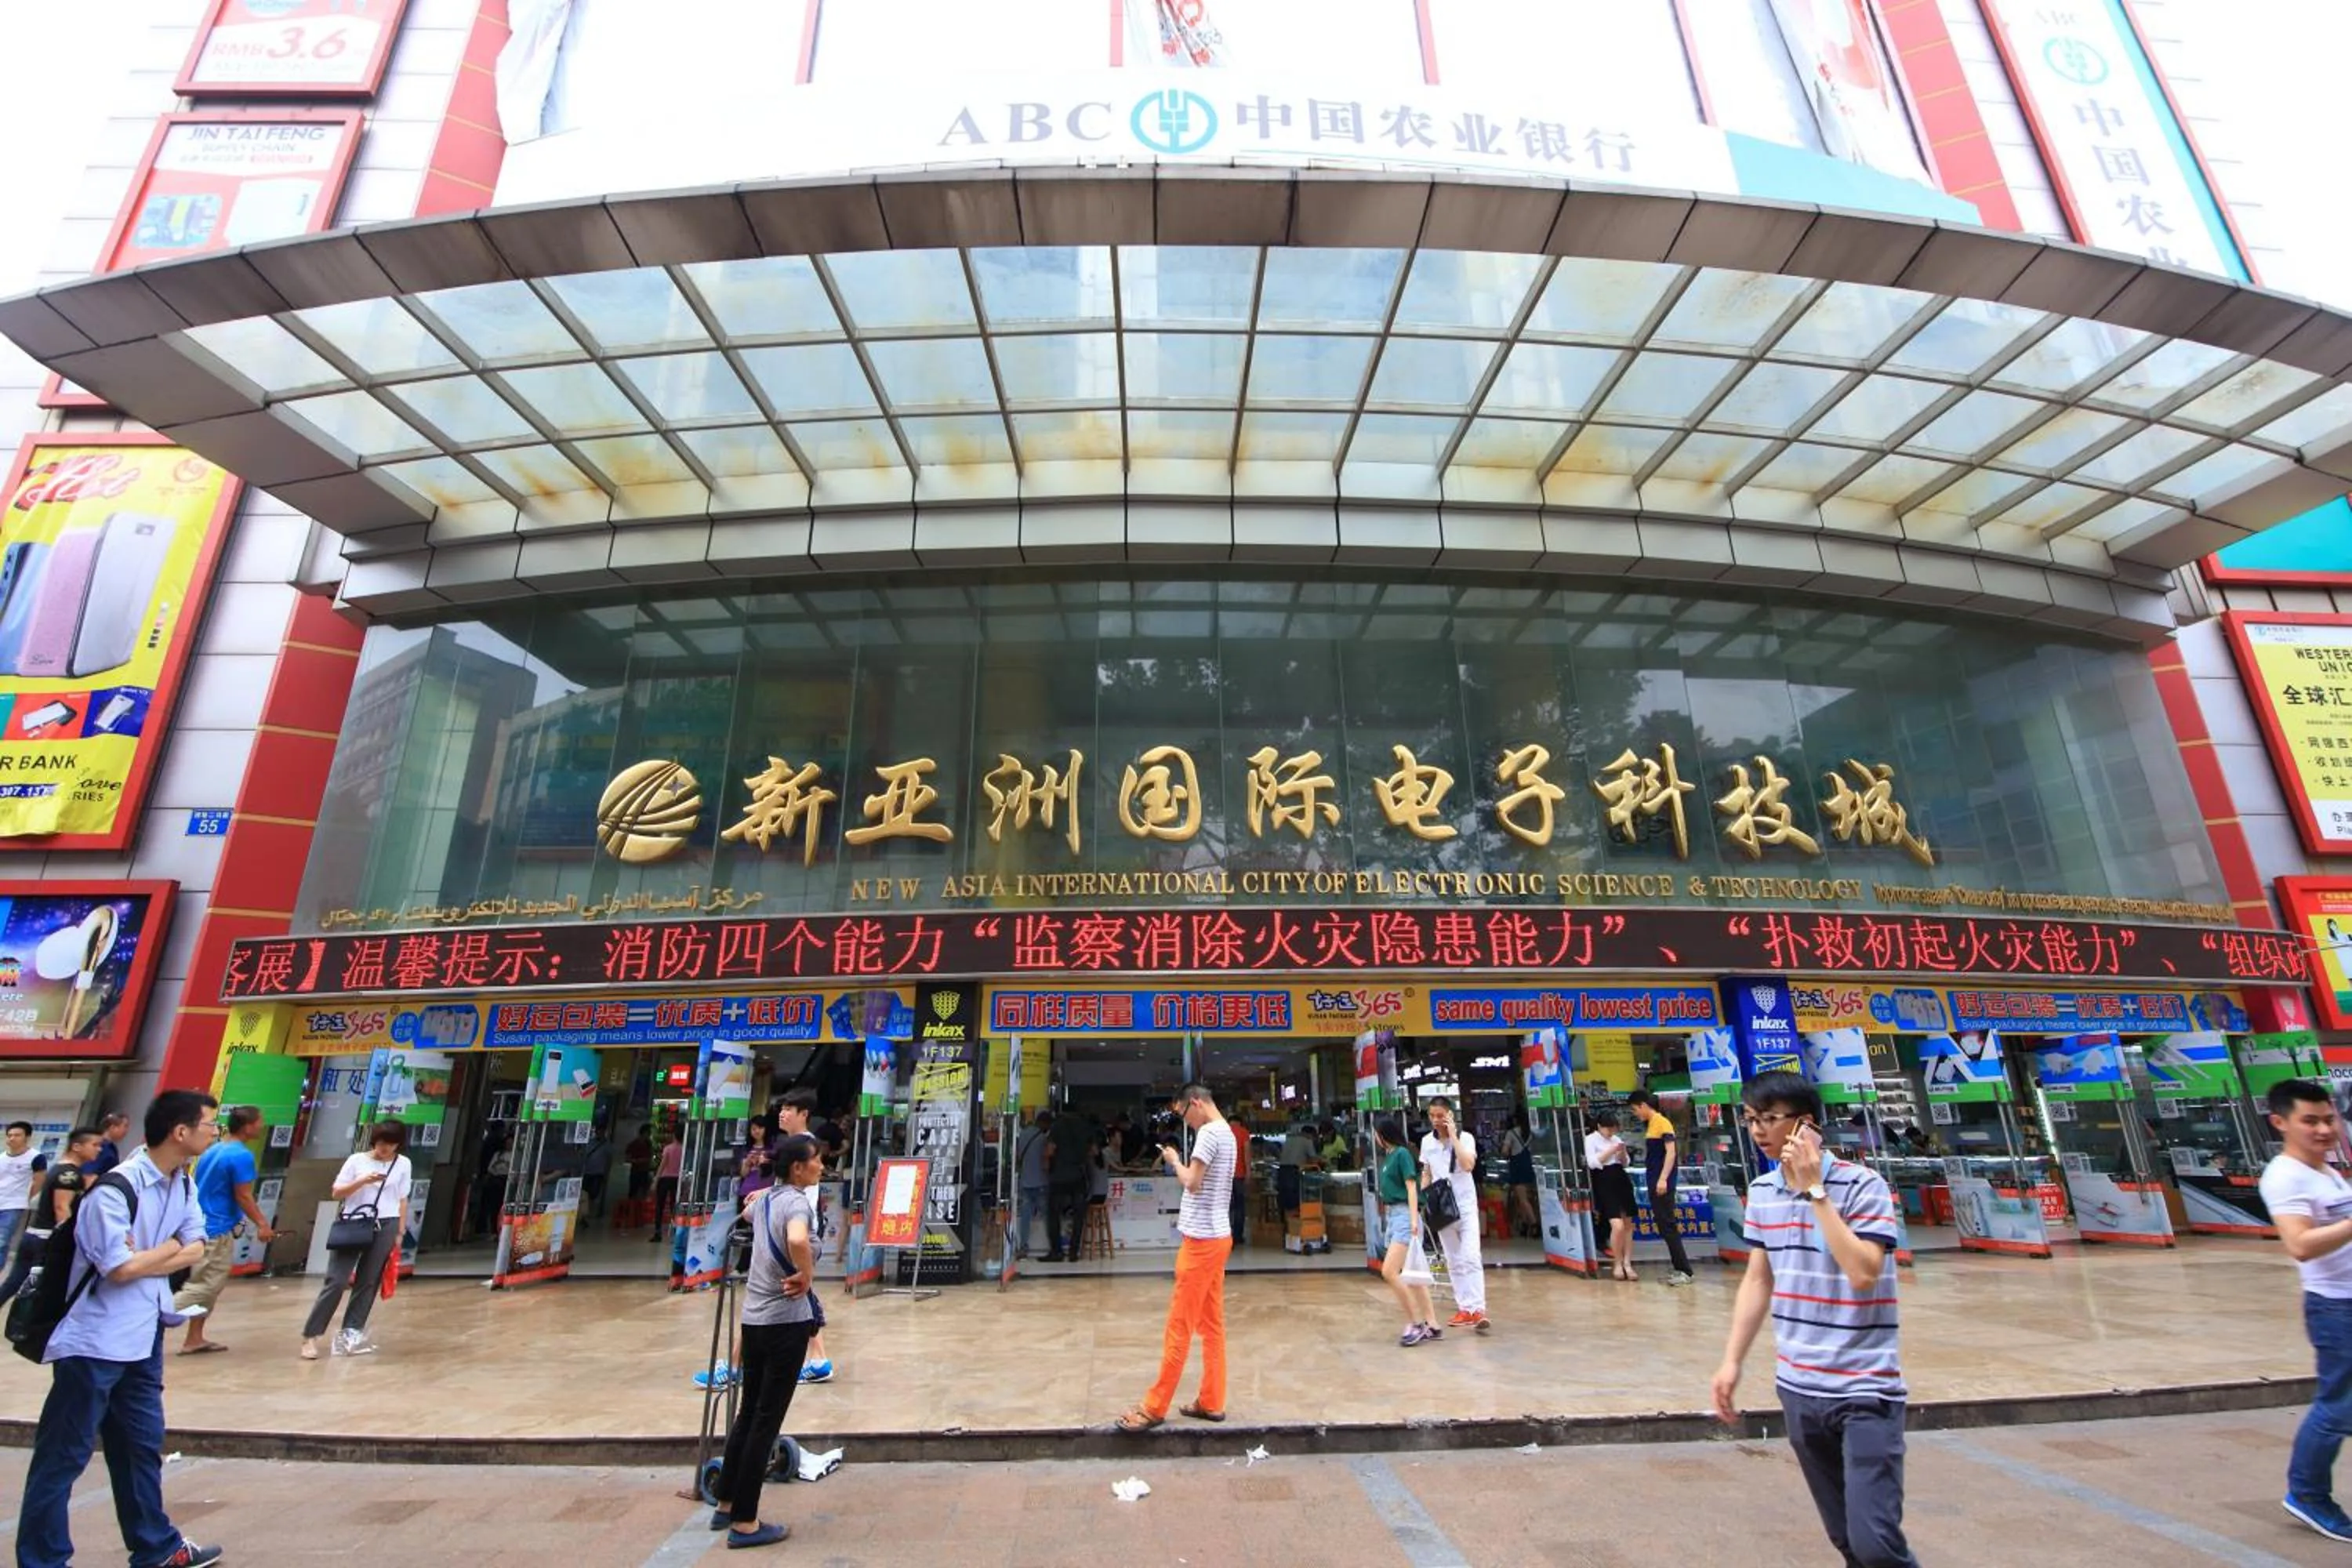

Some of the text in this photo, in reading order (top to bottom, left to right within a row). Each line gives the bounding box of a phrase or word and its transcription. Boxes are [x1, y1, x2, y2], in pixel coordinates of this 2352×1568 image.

[212, 26, 348, 60] RMB 3.6
[937, 100, 1113, 147] ABC
[187, 127, 325, 142] JIN TAI FENG
[1235, 94, 1637, 173] 中国农业银行
[251, 143, 296, 152] CHAIN
[18, 754, 79, 771] BANK
[72, 791, 104, 802] RIES
[720, 742, 1934, 868] 新亚洲国际电子科技城
[198, 819, 220, 833] 55
[850, 877, 921, 901] NEW
[942, 875, 1007, 898] ASIA
[1015, 872, 1235, 897] INTERNATIONAL
[1356, 871, 1546, 895] ELECTRONIC
[1558, 874, 1675, 897] SCIENCE
[1689, 876, 1708, 897] &
[1710, 877, 1864, 902] TECHNOLOGY
[994, 992, 1287, 1029] 同样质量 价格更低
[1436, 991, 1712, 1025] same quality lowest price
[922, 1022, 964, 1037] inkax
[1751, 1015, 1790, 1029] inkax
[494, 1025, 813, 1046] Susan packaging means lower price in good quality
[1756, 1037, 1791, 1049] 1F137
[922, 1046, 964, 1058] 1F137
[917, 1129, 960, 1146] CASE
[931, 1186, 956, 1201] THER
[926, 1201, 955, 1220] ISE
